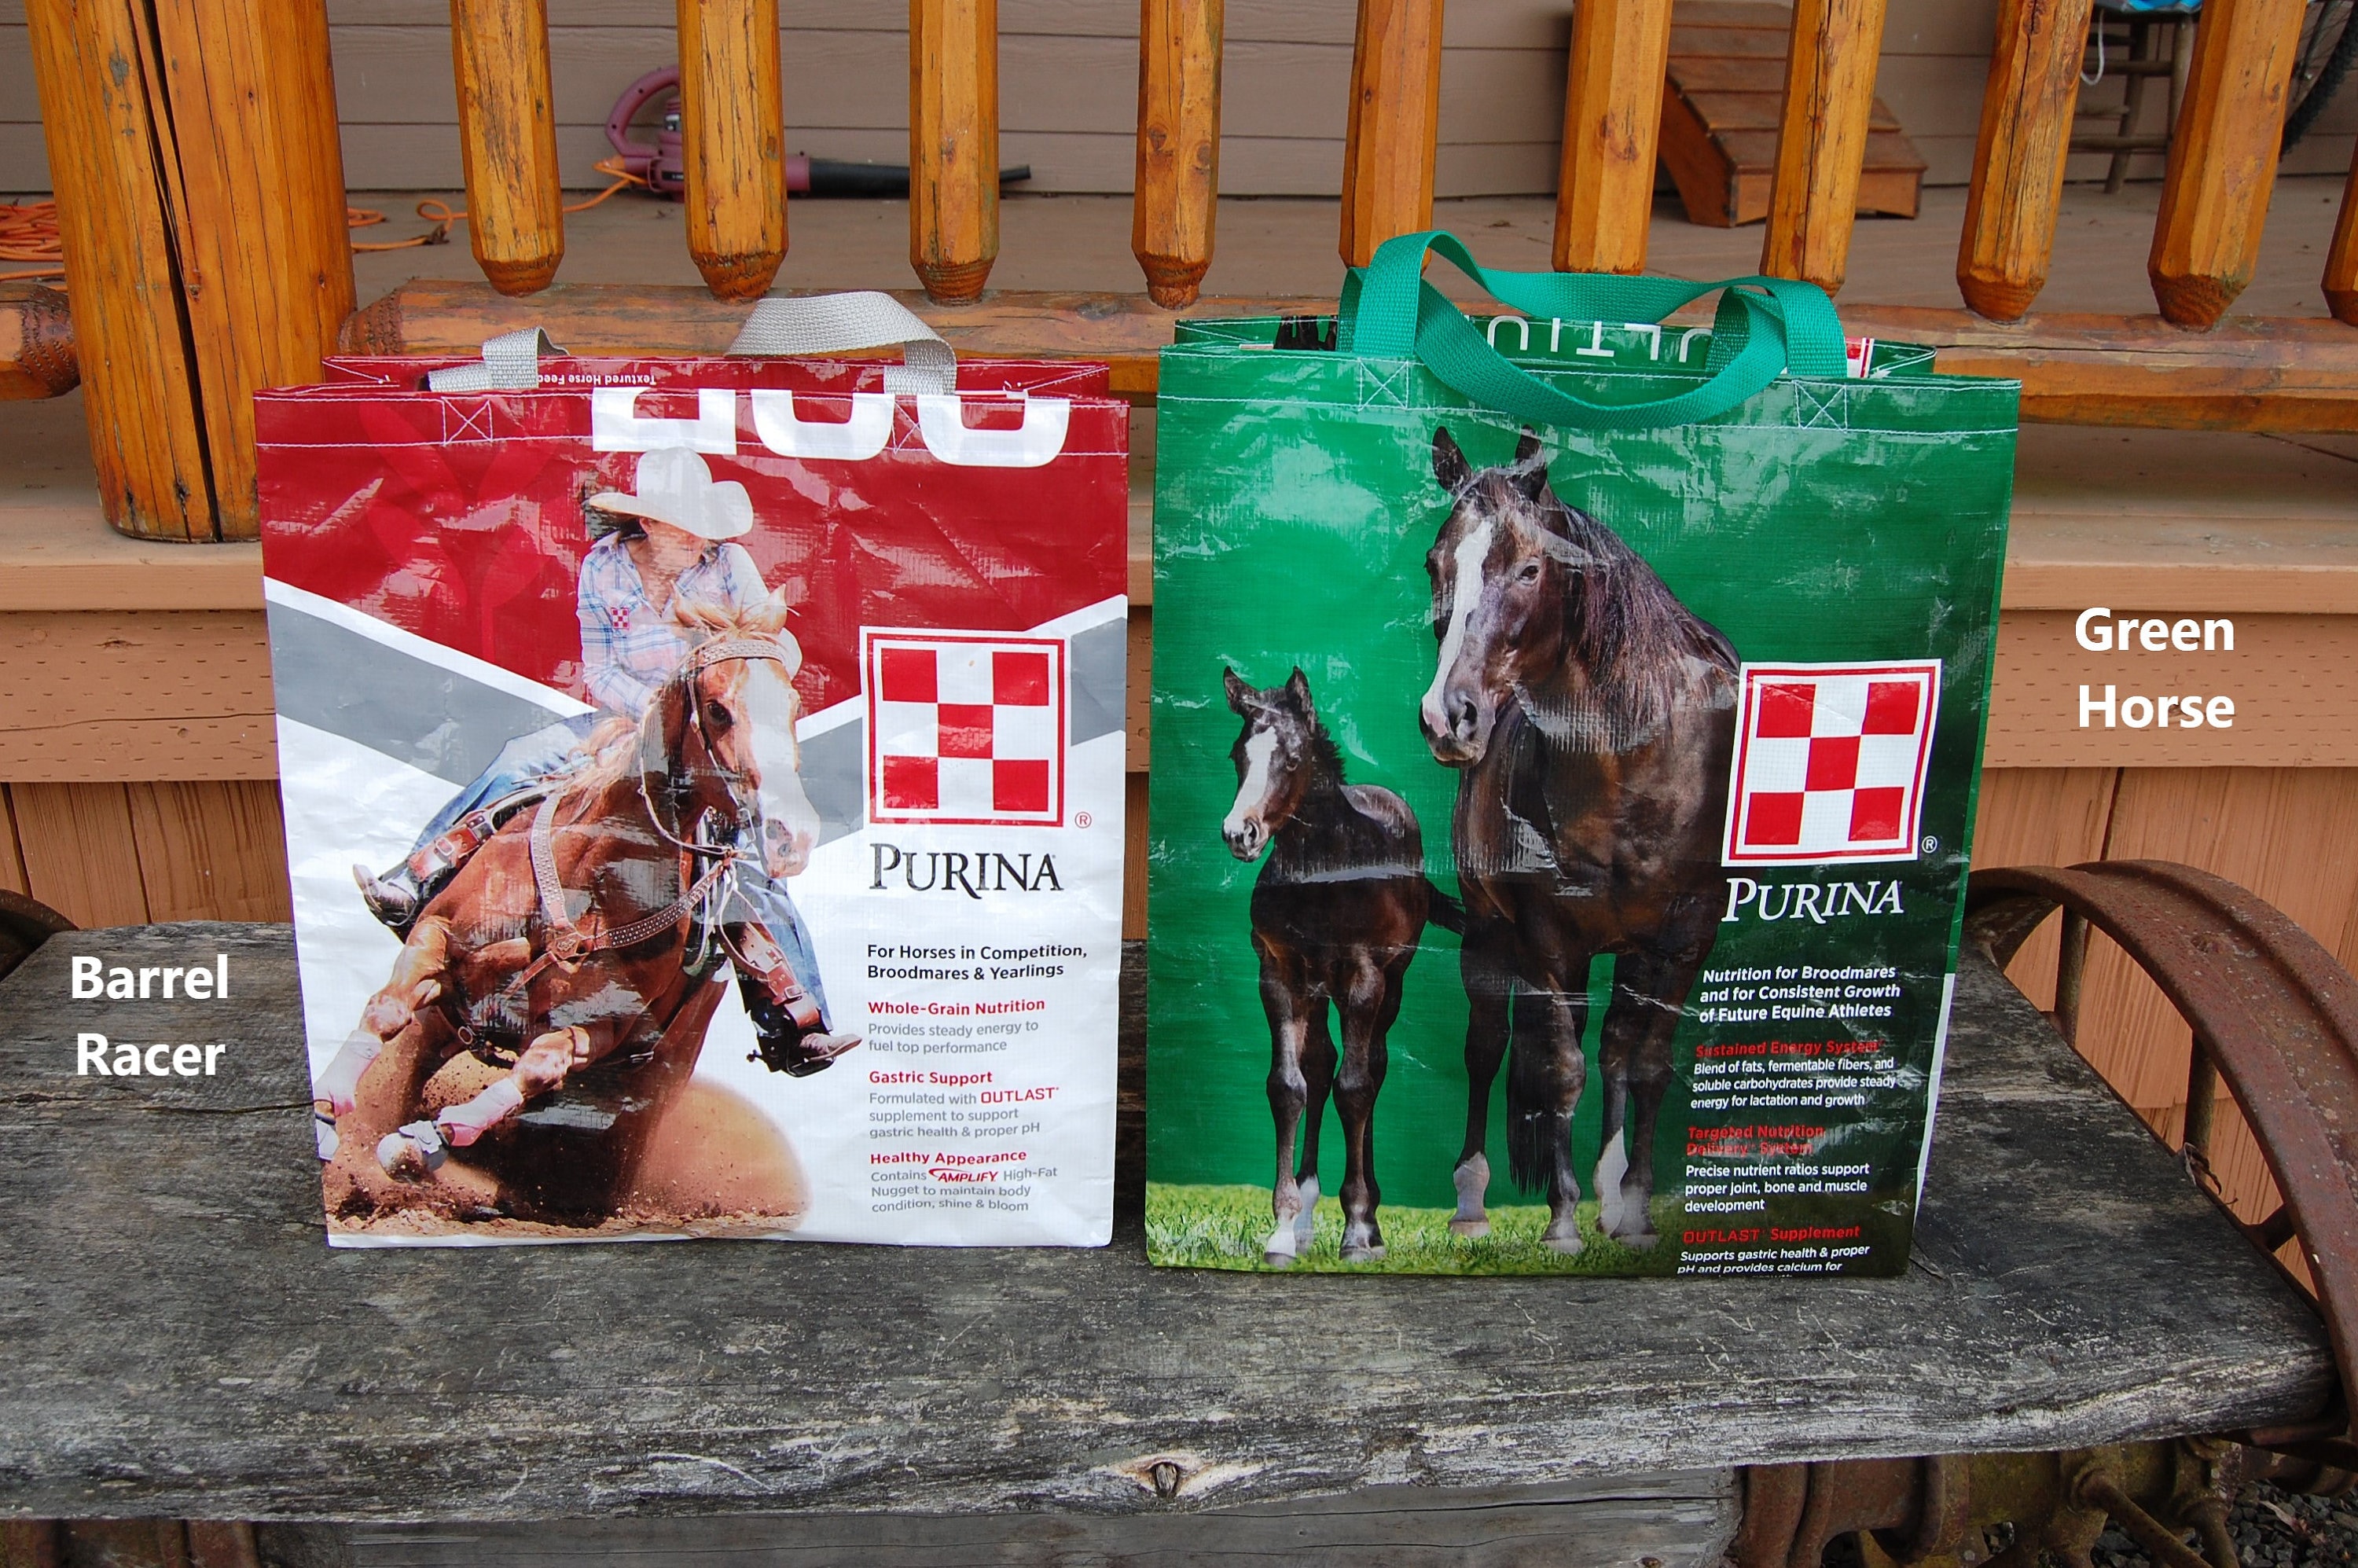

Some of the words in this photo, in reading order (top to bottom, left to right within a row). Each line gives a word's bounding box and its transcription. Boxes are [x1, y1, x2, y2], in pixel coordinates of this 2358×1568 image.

[1462, 314, 1713, 363] ULTIU
[568, 374, 601, 385] Horse
[605, 374, 656, 385] Textured
[869, 843, 1064, 899] PURINA
[1721, 878, 1904, 924] PURINA
[868, 945, 894, 958] For
[900, 945, 956, 959] Horses
[960, 946, 975, 959] in
[980, 945, 1087, 960] Competition,
[868, 965, 969, 979] Broodmares
[974, 968, 984, 980] &
[990, 964, 1063, 979] Yearlings
[1703, 968, 1771, 982] Nutrition
[1776, 966, 1797, 979] for
[1802, 965, 1896, 979] Broodmares
[1700, 988, 1728, 1002] and
[1733, 987, 1754, 1001] for
[1759, 984, 1840, 1000] Consistent
[1844, 985, 1901, 998] Growth
[868, 1002, 970, 1015] Whole-Grain
[975, 999, 1045, 1015] Nutrition
[1699, 1008, 1714, 1023] of
[1718, 1007, 1767, 1022] Future
[1772, 1004, 1824, 1020] Equine
[1828, 1004, 1891, 1018] Athletes
[869, 1023, 924, 1036] Provides
[929, 1025, 972, 1038] steady
[977, 1022, 1021, 1036] energy
[1026, 1021, 1038, 1031] to
[869, 1040, 893, 1051] fuel
[897, 1041, 919, 1054] top
[923, 1041, 1007, 1055] performance
[1695, 1041, 1766, 1057] Sustained
[1771, 1041, 1821, 1055] Energy
[1694, 1061, 1725, 1074] Blend
[1728, 1060, 1739, 1072] of
[1742, 1060, 1765, 1073] fats,
[1768, 1059, 1835, 1072] fermentable
[1838, 1058, 1872, 1071] fibers,
[1875, 1058, 1893, 1069] and
[869, 1071, 924, 1083] Gastric
[930, 1071, 993, 1087] Support
[1692, 1080, 1731, 1092] soluble
[1733, 1078, 1813, 1090] carbohydrates
[1816, 1077, 1857, 1090] provide
[1860, 1075, 1896, 1088] steady
[869, 1092, 944, 1104] Formulated
[949, 1092, 976, 1104] with
[1690, 1098, 1728, 1109] energy
[1732, 1096, 1746, 1107] for
[1750, 1095, 1798, 1106] lactation
[1800, 1095, 1823, 1106] and
[1825, 1094, 1865, 1107] growth
[869, 1110, 946, 1122] supplement
[951, 1111, 964, 1121] to
[968, 1109, 1019, 1122] support
[869, 1127, 913, 1138] gastric
[917, 1127, 957, 1137] health
[962, 1127, 970, 1137] &
[975, 1126, 1018, 1138] proper
[1022, 1122, 1040, 1134] pH
[1688, 1126, 1753, 1139] Targeted
[1757, 1125, 1824, 1138] Nutrition
[870, 1153, 929, 1164] Healthy
[935, 1151, 1027, 1165] Appearance
[871, 1171, 927, 1182] Contains
[928, 1168, 999, 1183] AMPLIFY
[1004, 1168, 1057, 1182] High-Fat
[1686, 1165, 1730, 1177] Precise
[1734, 1164, 1781, 1177] nutrient
[1785, 1163, 1818, 1175] ratios
[1822, 1163, 1870, 1177] support
[872, 1186, 919, 1197] Nugget
[923, 1186, 935, 1195] to
[940, 1187, 995, 1195] maintain
[999, 1185, 1030, 1197] body
[1685, 1184, 1727, 1196] proper
[1730, 1182, 1761, 1195] joint,
[1765, 1182, 1795, 1193] bone
[1798, 1181, 1822, 1192] and
[1824, 1180, 1868, 1192] muscle
[872, 1201, 935, 1213] condition,
[938, 1199, 971, 1208] shine
[975, 1199, 984, 1208] &
[989, 1200, 1028, 1211] bloom
[1684, 1199, 1765, 1213] development
[1770, 1225, 1860, 1242] Supplement
[1680, 1251, 1735, 1263] Supports
[1737, 1250, 1777, 1261] gastric
[1780, 1247, 1816, 1259] health
[1819, 1248, 1828, 1257] &
[1831, 1245, 1870, 1258] proper
[1677, 1265, 1695, 1274] pH
[1698, 1264, 1721, 1273] and
[1723, 1263, 1774, 1274] provides
[1777, 1263, 1822, 1272] calcium
[1825, 1262, 1842, 1272] for
